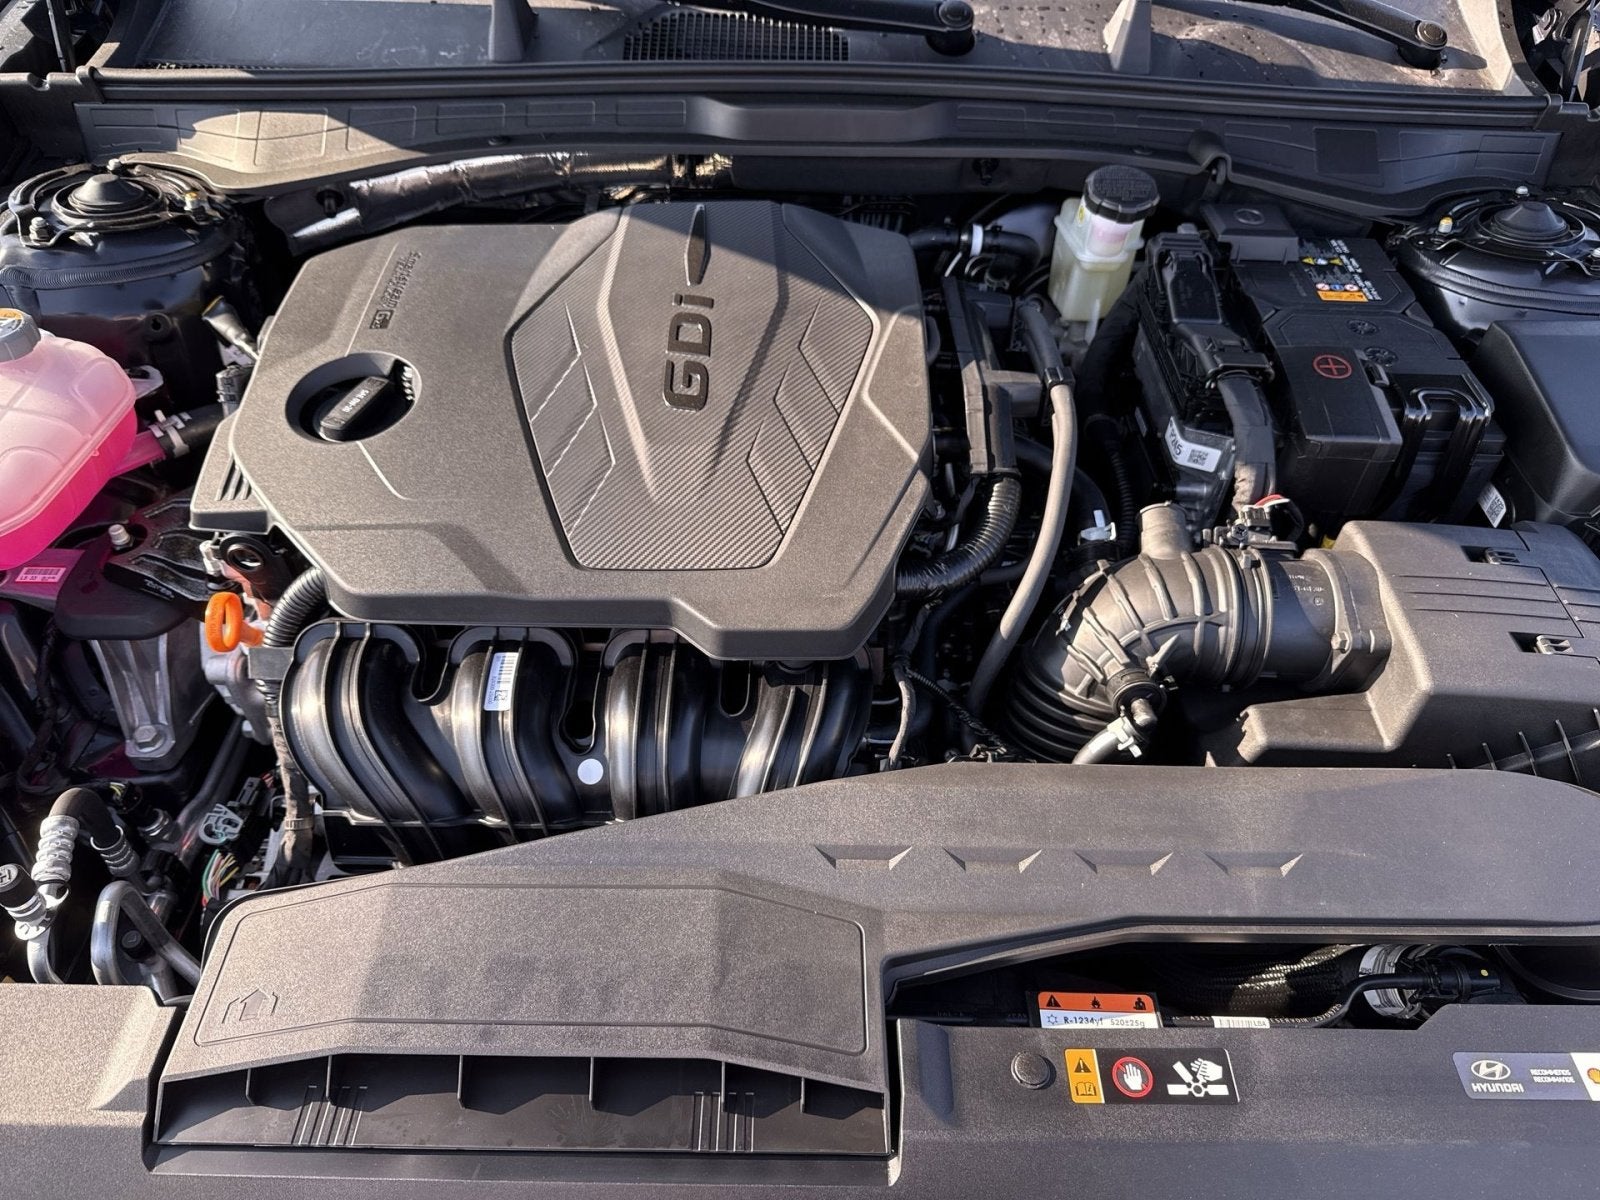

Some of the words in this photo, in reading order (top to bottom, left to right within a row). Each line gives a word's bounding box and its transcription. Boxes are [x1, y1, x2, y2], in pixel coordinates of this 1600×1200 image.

[661, 293, 715, 413] GDi
[1063, 1016, 1104, 1027] R-1234yf
[1471, 1083, 1525, 1093] HYUNDAI
